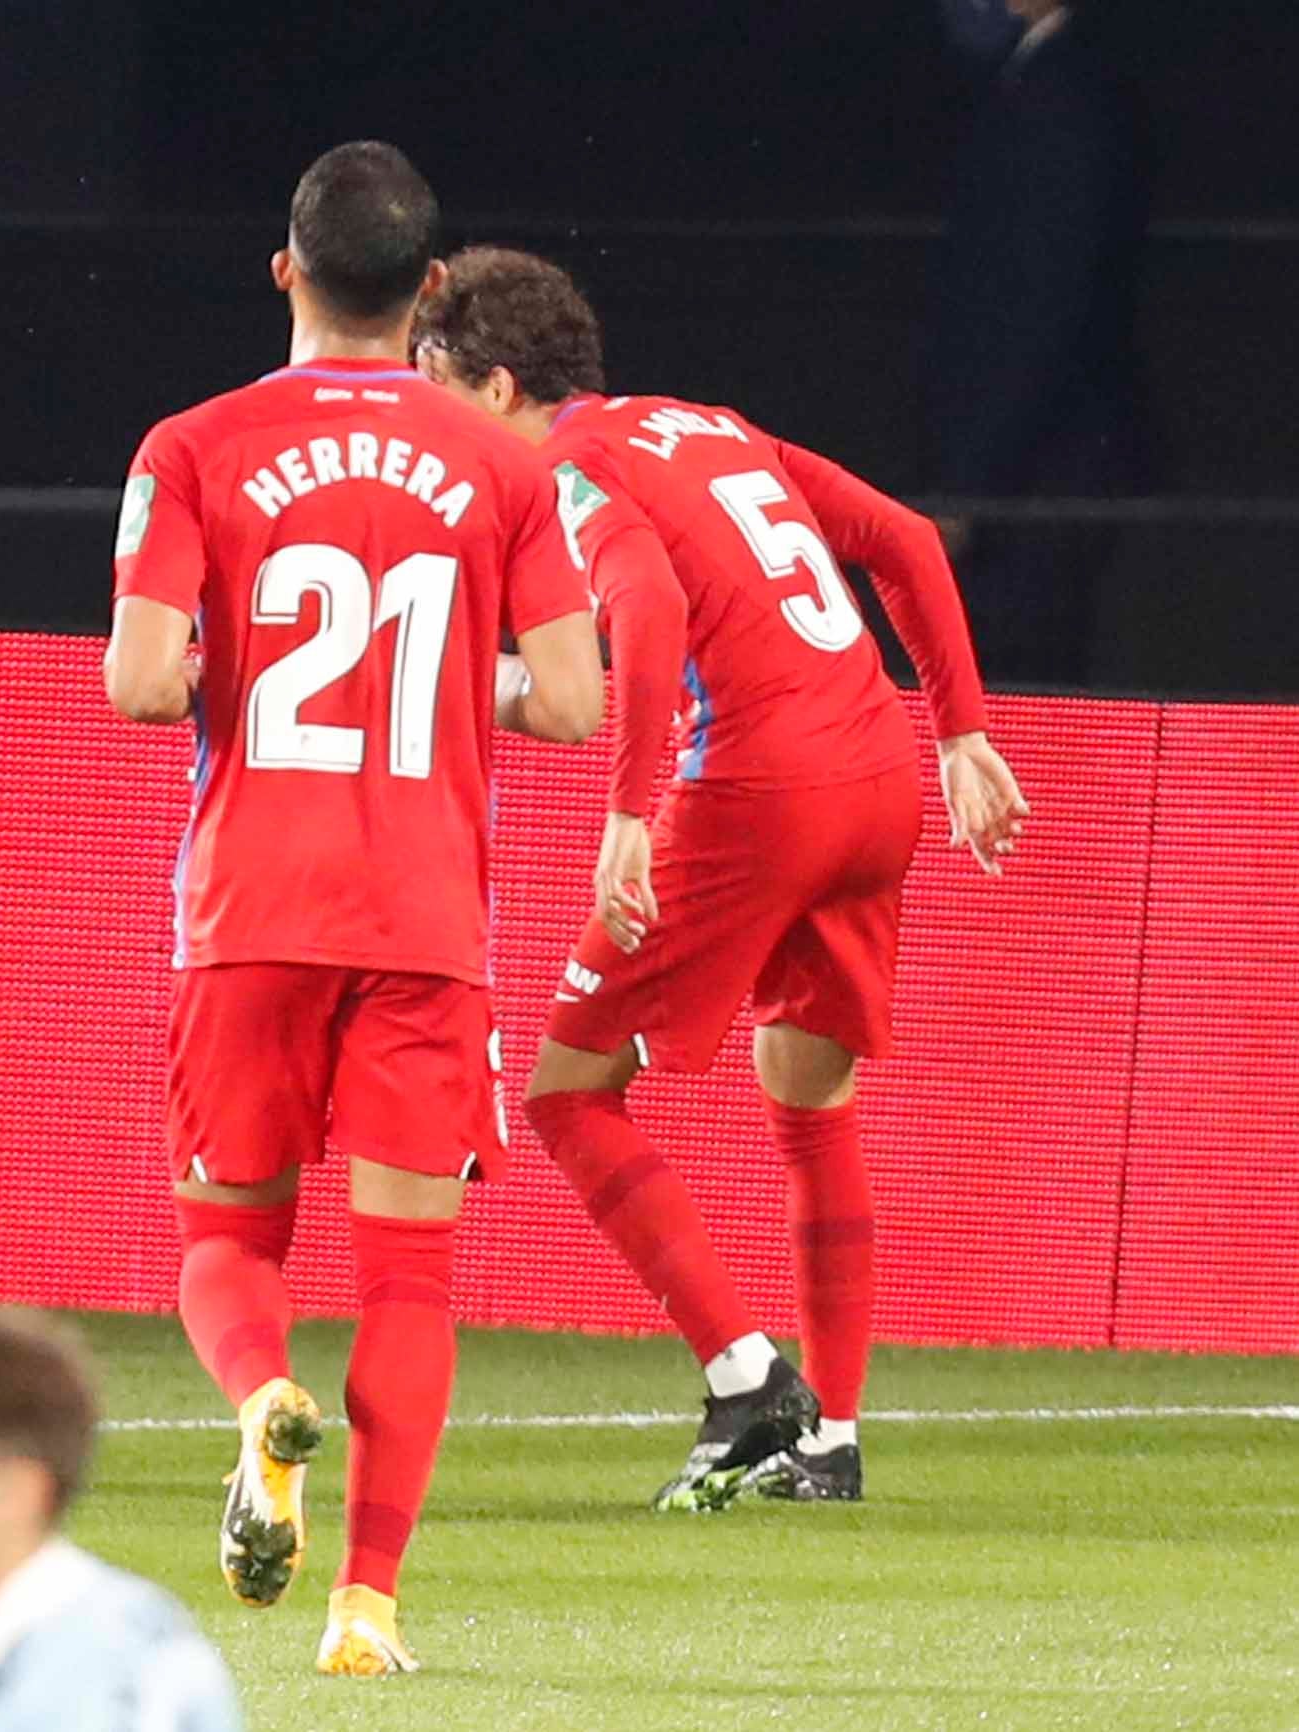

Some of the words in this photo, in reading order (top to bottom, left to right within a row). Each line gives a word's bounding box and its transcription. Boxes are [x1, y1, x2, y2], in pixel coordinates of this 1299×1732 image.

[242, 432, 474, 527] HERRERA
[708, 470, 863, 652] 5
[246, 543, 457, 779] 21
